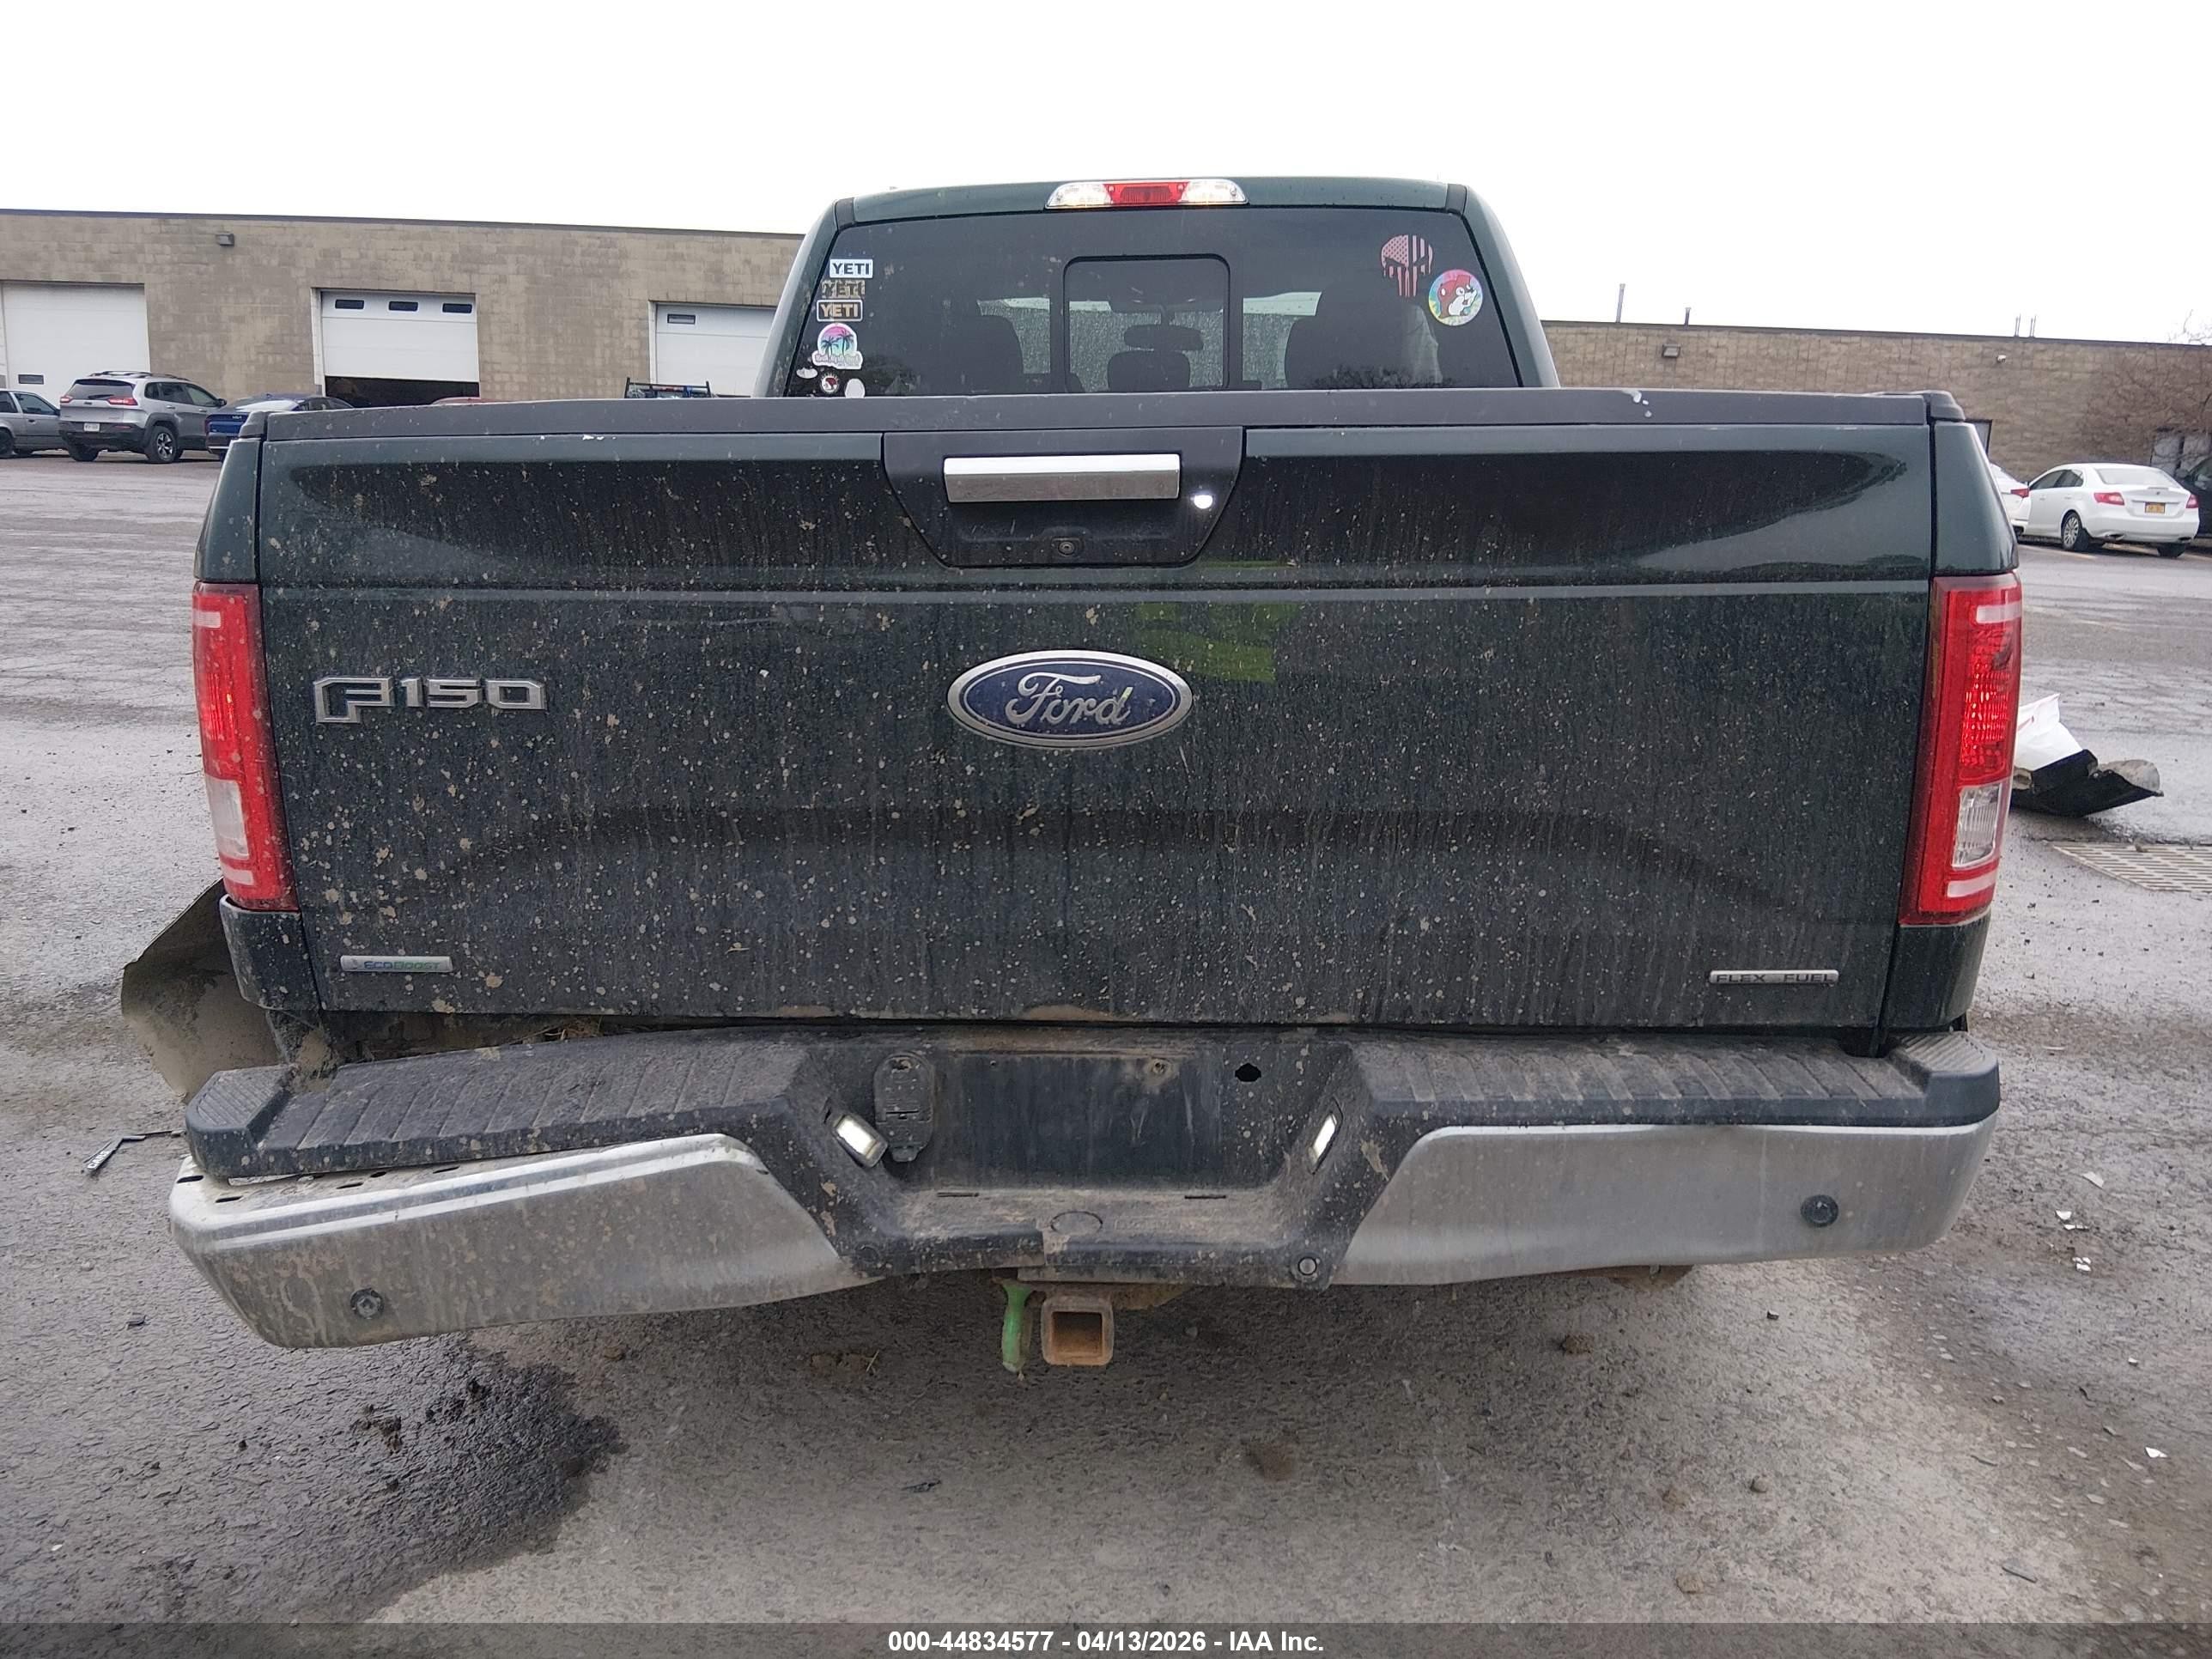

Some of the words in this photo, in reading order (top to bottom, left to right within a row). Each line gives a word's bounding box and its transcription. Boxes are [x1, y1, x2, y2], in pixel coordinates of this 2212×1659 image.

[832, 263, 870, 275] YETI
[824, 282, 862, 297] YETI
[820, 303, 859, 318] YETI
[1005, 672, 1133, 725] Ford
[1717, 974, 1765, 982] FLEX
[1784, 973, 1834, 982] FUEL
